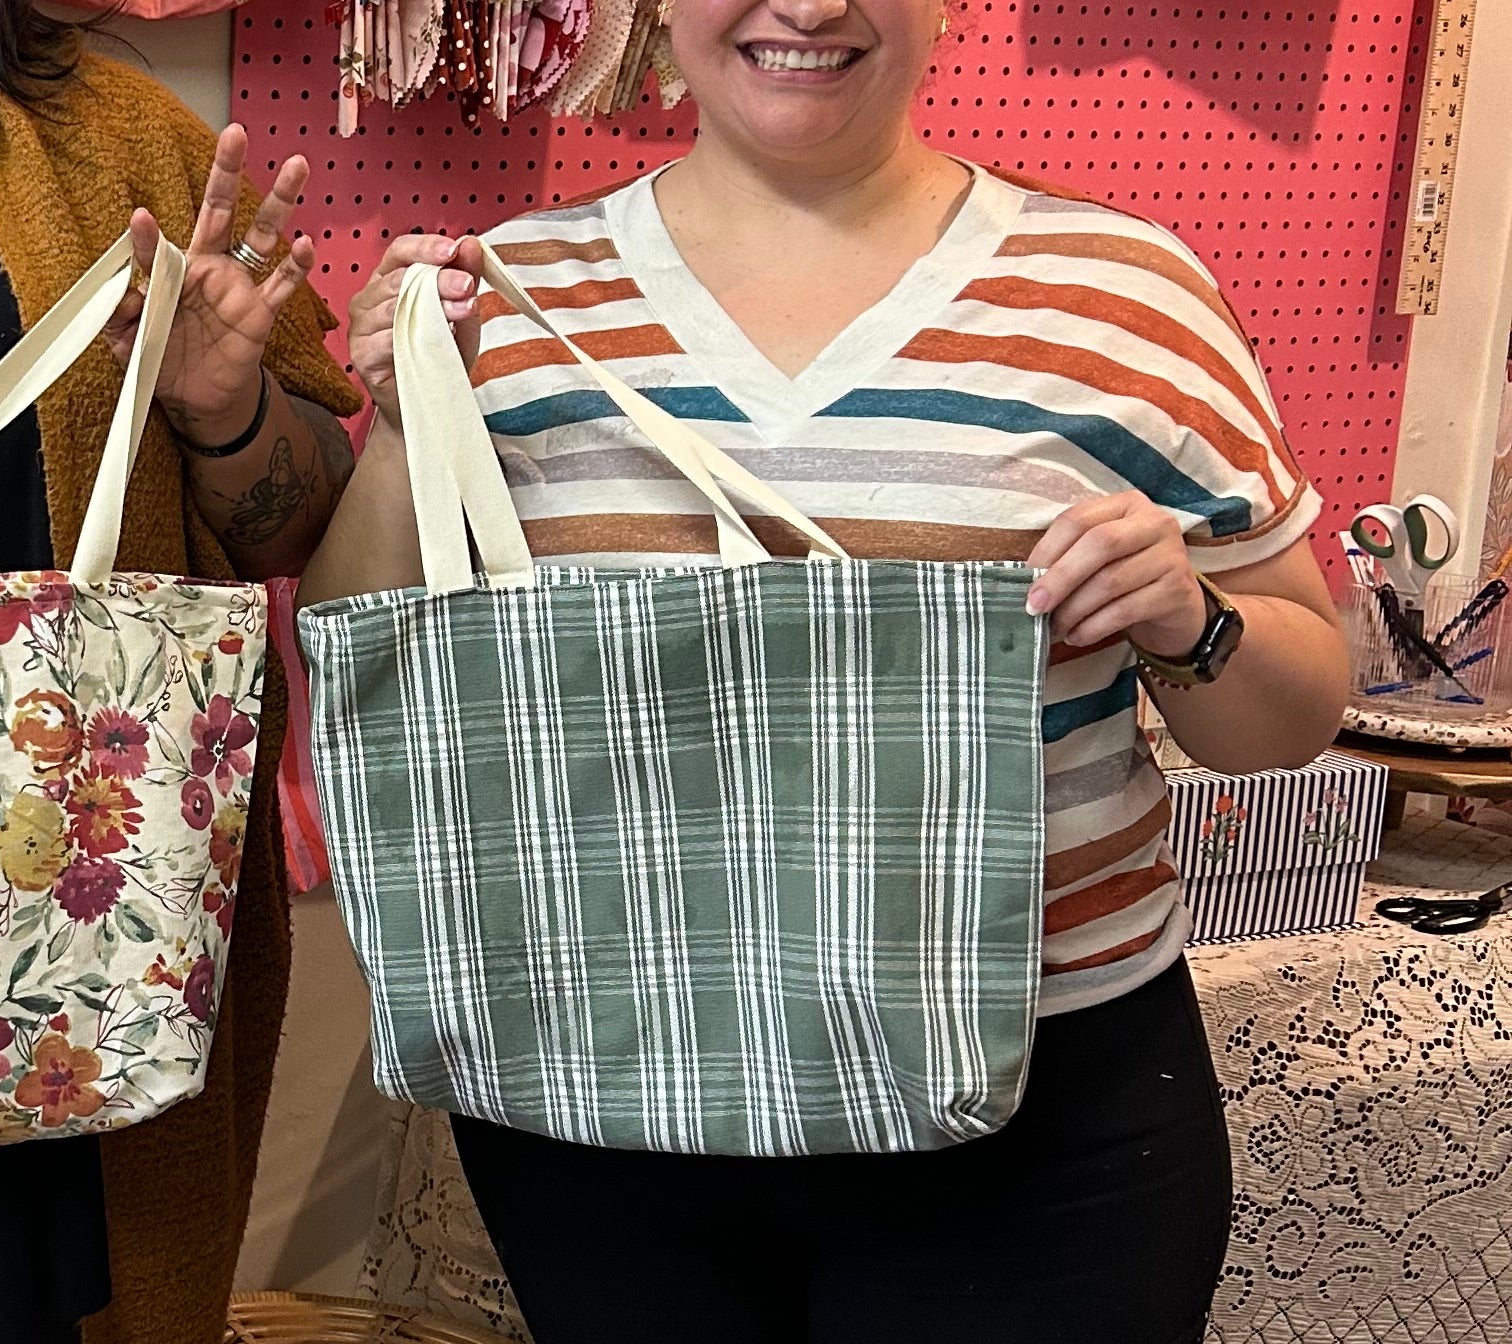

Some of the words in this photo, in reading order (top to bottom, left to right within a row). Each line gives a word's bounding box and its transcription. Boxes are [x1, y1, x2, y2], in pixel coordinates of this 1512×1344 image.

[1460, 14, 1468, 28] 26
[1456, 44, 1464, 57] 27
[1452, 74, 1460, 87] 28
[1449, 103, 1456, 117] 29
[1445, 133, 1453, 147] 30
[1441, 162, 1448, 175] 31
[1437, 192, 1445, 205] 32
[1434, 221, 1441, 234] 33
[1430, 250, 1437, 263] 34
[1426, 279, 1434, 292] 35
[1424, 301, 1431, 314] 36
